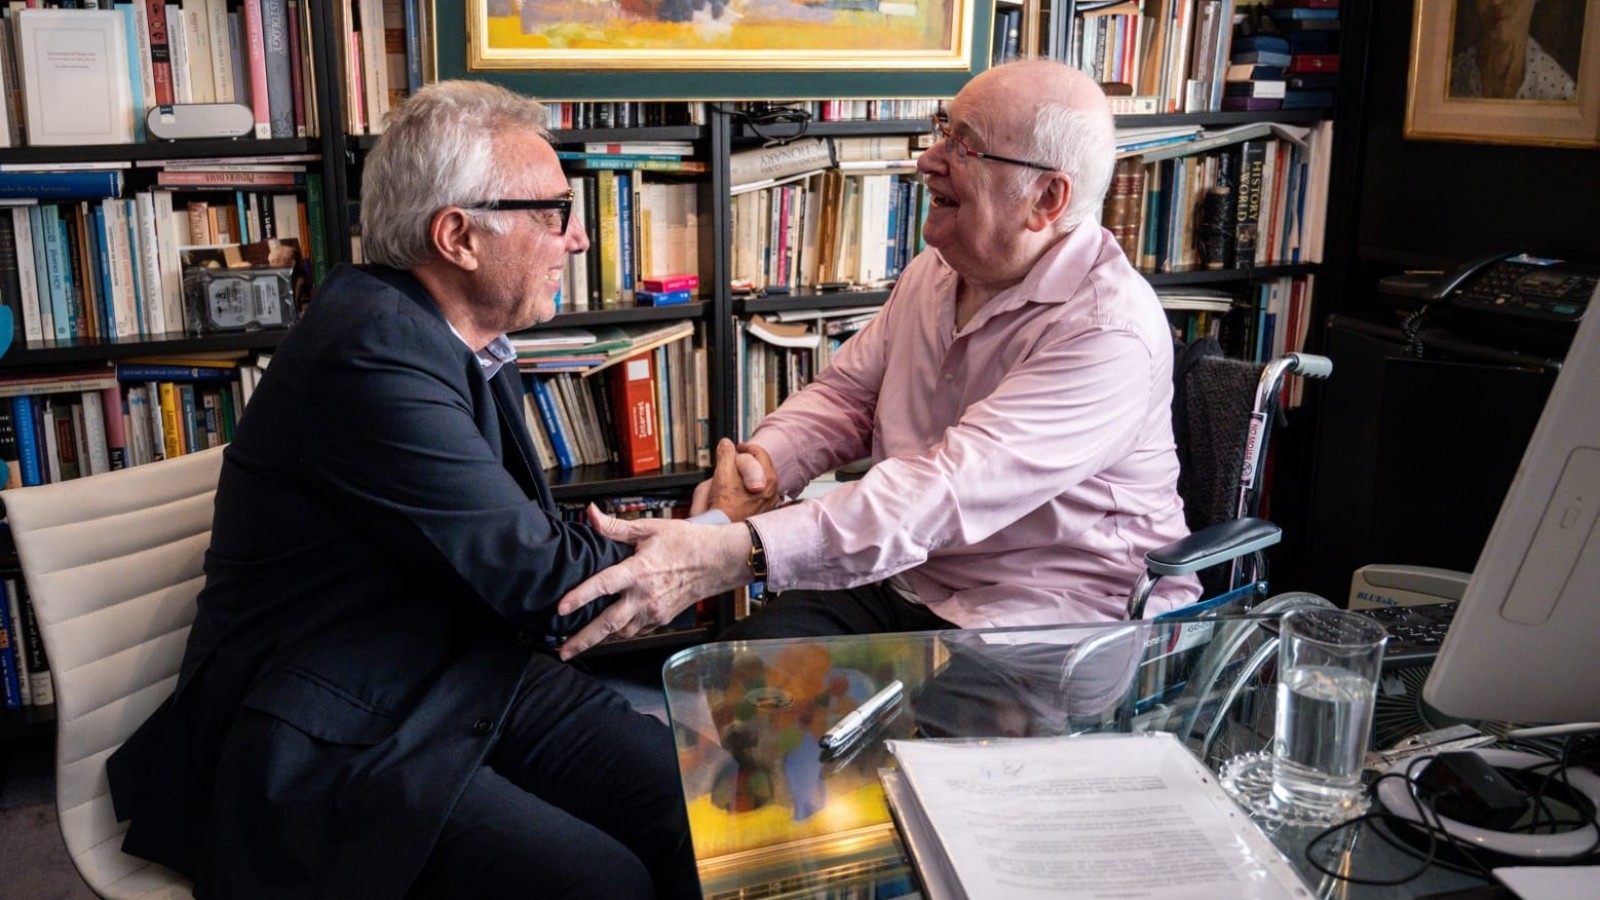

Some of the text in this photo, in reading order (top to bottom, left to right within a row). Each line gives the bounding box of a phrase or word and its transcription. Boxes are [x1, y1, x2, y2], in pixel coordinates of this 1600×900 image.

[270, 0, 286, 54] ISTOLOGY
[1236, 171, 1250, 222] WORLD
[1248, 160, 1262, 221] HISTORY
[637, 400, 646, 439] Internet
